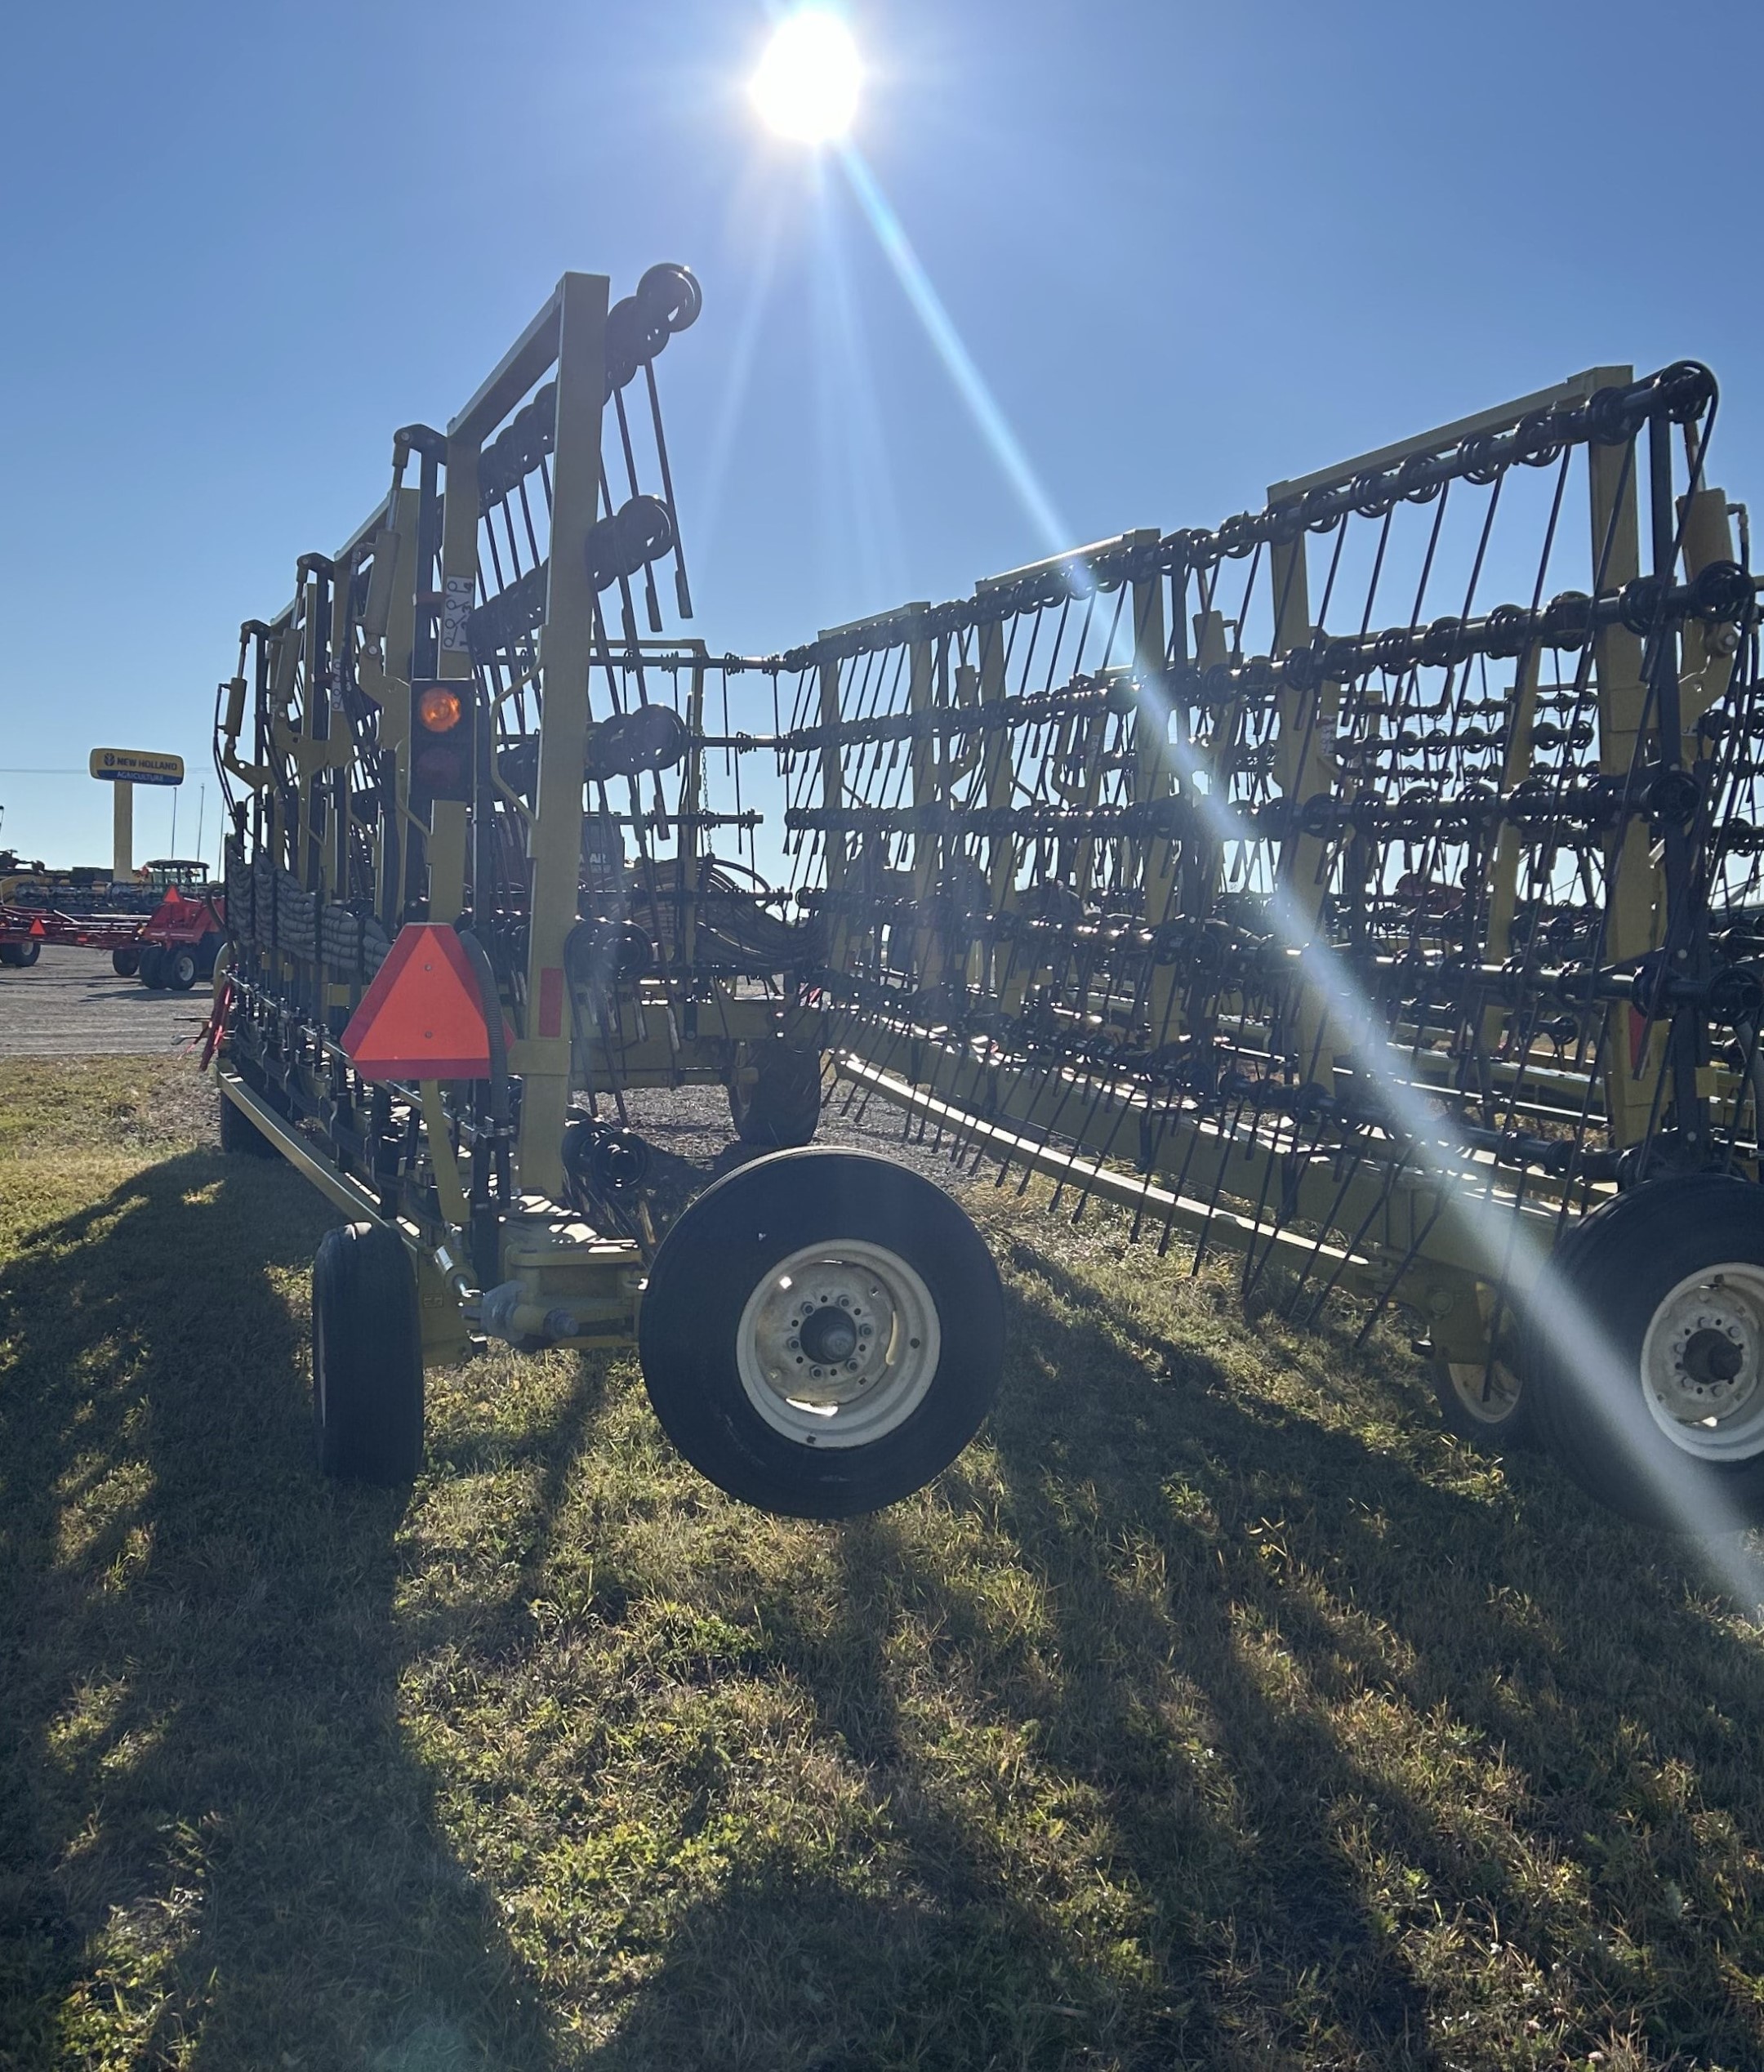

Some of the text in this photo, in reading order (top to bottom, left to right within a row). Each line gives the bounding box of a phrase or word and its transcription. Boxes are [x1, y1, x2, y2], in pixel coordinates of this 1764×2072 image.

[117, 757, 177, 771] NEW HOLLAND
[117, 771, 163, 781] AGRICULTURE
